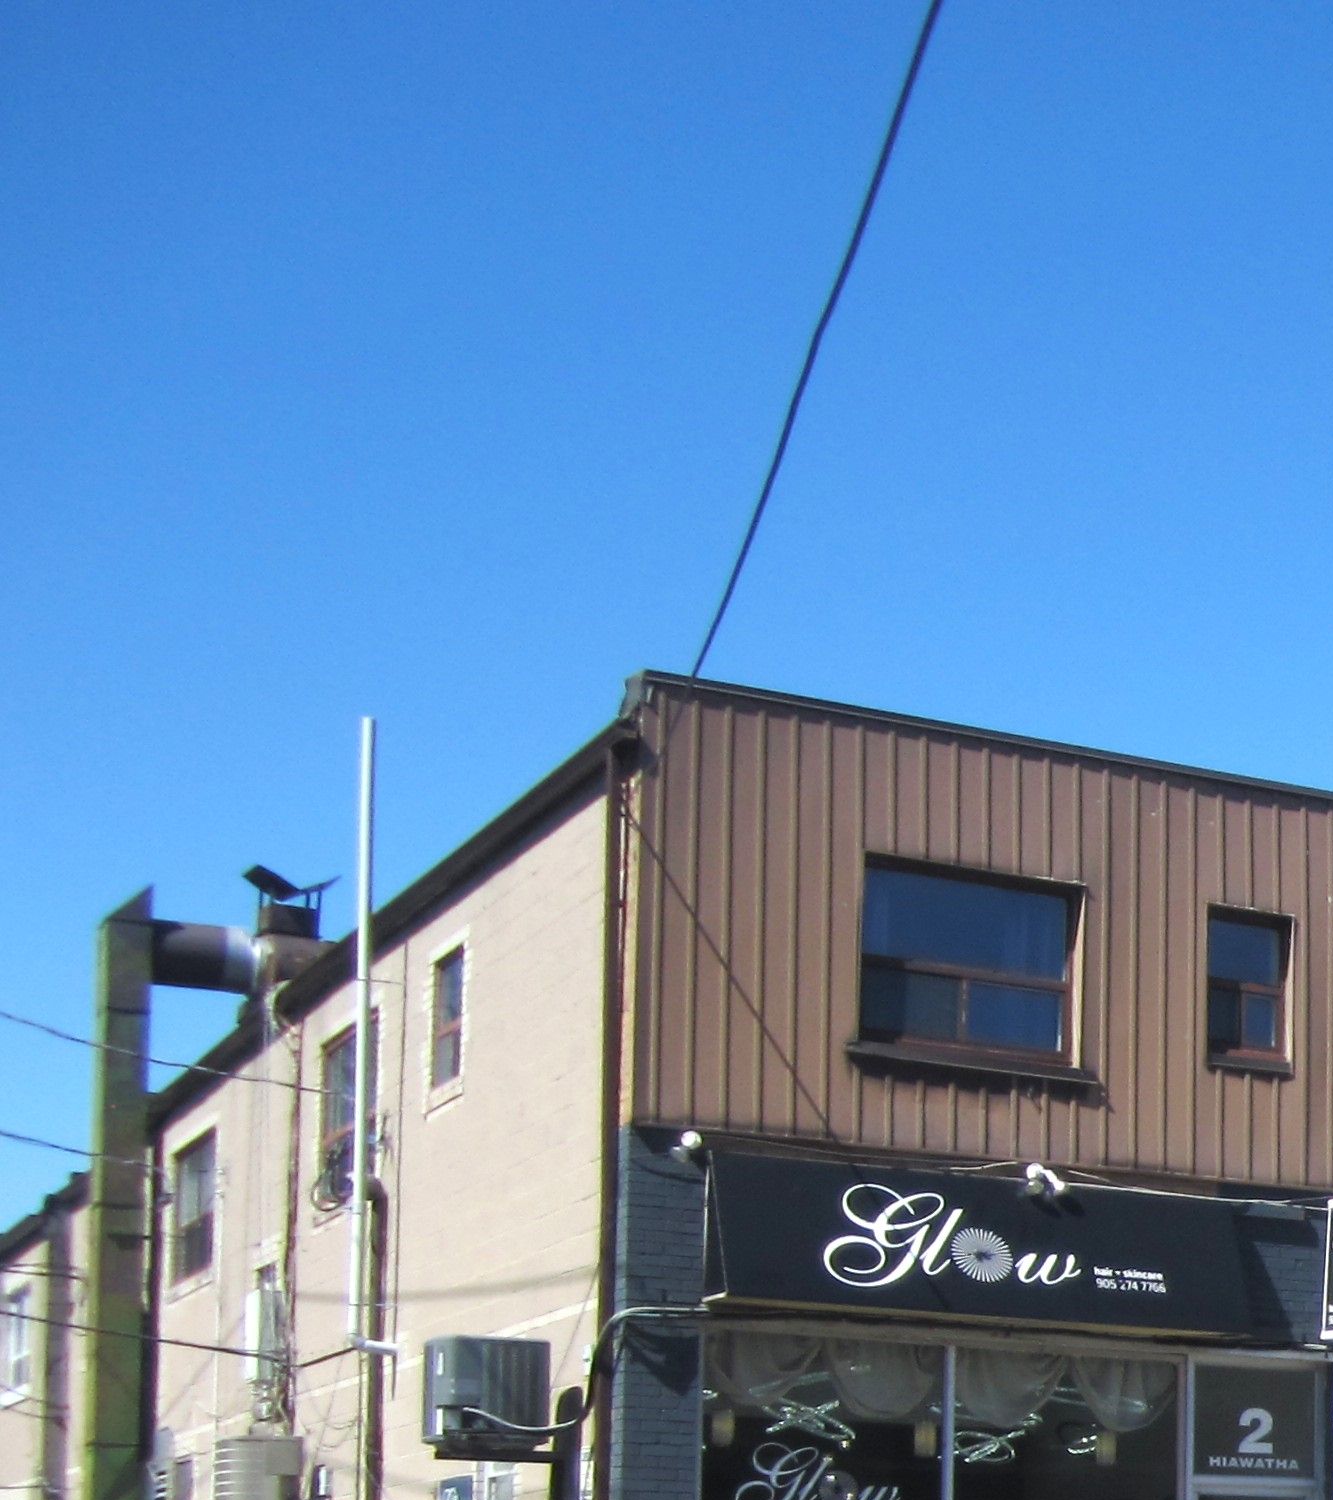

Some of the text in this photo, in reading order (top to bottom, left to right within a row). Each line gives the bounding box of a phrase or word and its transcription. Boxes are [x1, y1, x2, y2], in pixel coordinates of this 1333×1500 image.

[823, 1184, 1081, 1287] Glow
[1096, 1278, 1117, 1290] 905
[1238, 1408, 1273, 1454] 2
[1208, 1456, 1299, 1469] HIAWATHA
